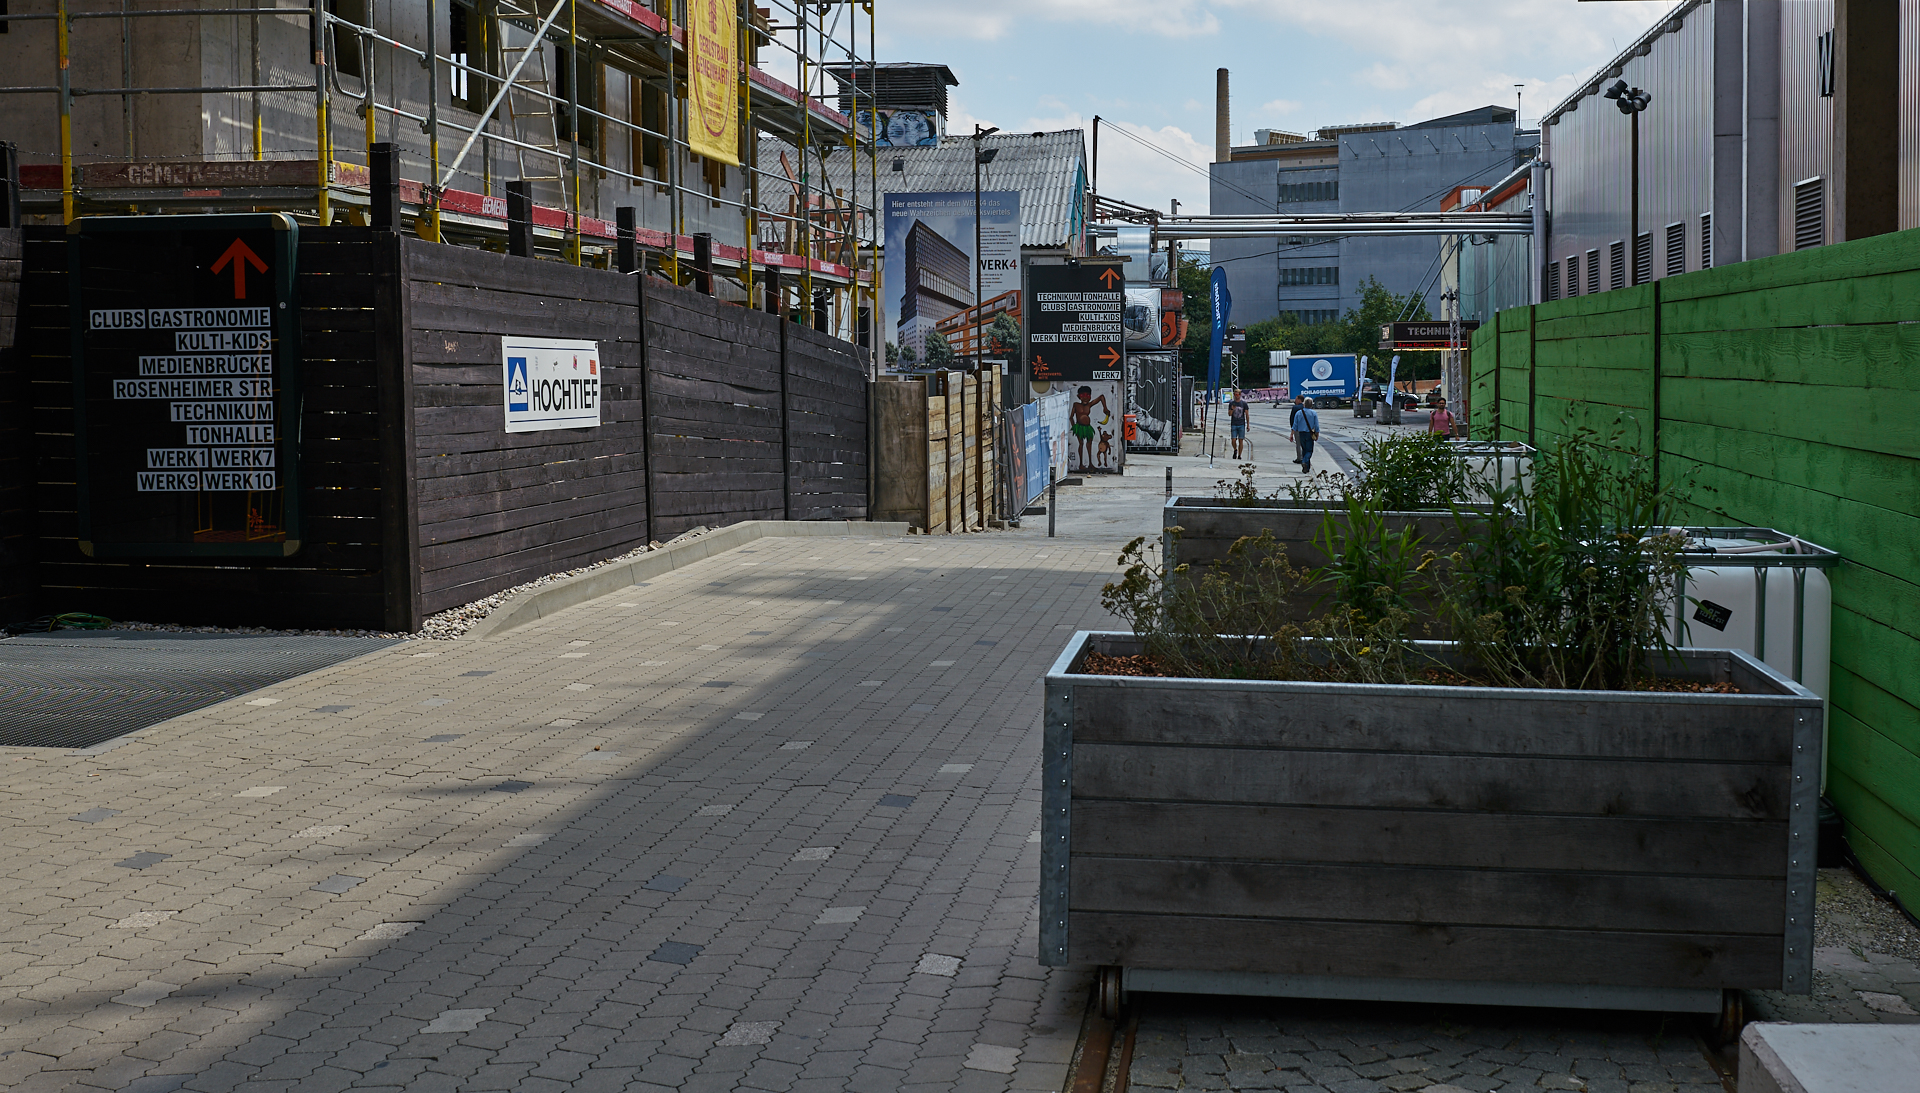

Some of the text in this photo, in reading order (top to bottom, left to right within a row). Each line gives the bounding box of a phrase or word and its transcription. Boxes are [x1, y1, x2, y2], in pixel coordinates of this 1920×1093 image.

[698, 33, 729, 65] GERÜSTBAU
[891, 200, 906, 208] Hier
[907, 200, 934, 208] entsteht
[936, 199, 946, 207] mit
[947, 199, 961, 207] dem
[988, 199, 1001, 207] das
[909, 209, 952, 217] Wahrzeichen
[966, 208, 1011, 217] Weksviertels
[1083, 293, 1120, 301] TONHALLE
[1041, 303, 1120, 311] CLUBS GASTRONOMIE
[92, 309, 270, 329] CLUBS GASTRONOMIE
[1079, 313, 1120, 321] KULTI-KIDS
[1063, 322, 1120, 332] MEDIENBRÜCKE
[178, 332, 270, 351] KULTI-KIDS
[1090, 334, 1120, 342] WERK10
[142, 354, 271, 375] MEDIENBRÜCKE
[1094, 371, 1120, 379] WERK7
[116, 379, 271, 399] ROSENHEIMER STR
[532, 378, 599, 412] HOCHTIEF
[173, 403, 272, 421] TECHNIKUM
[189, 426, 273, 444] TONHALLE
[149, 449, 273, 467] WERK1 WERK7
[139, 473, 274, 490] WERK9 WERK10
